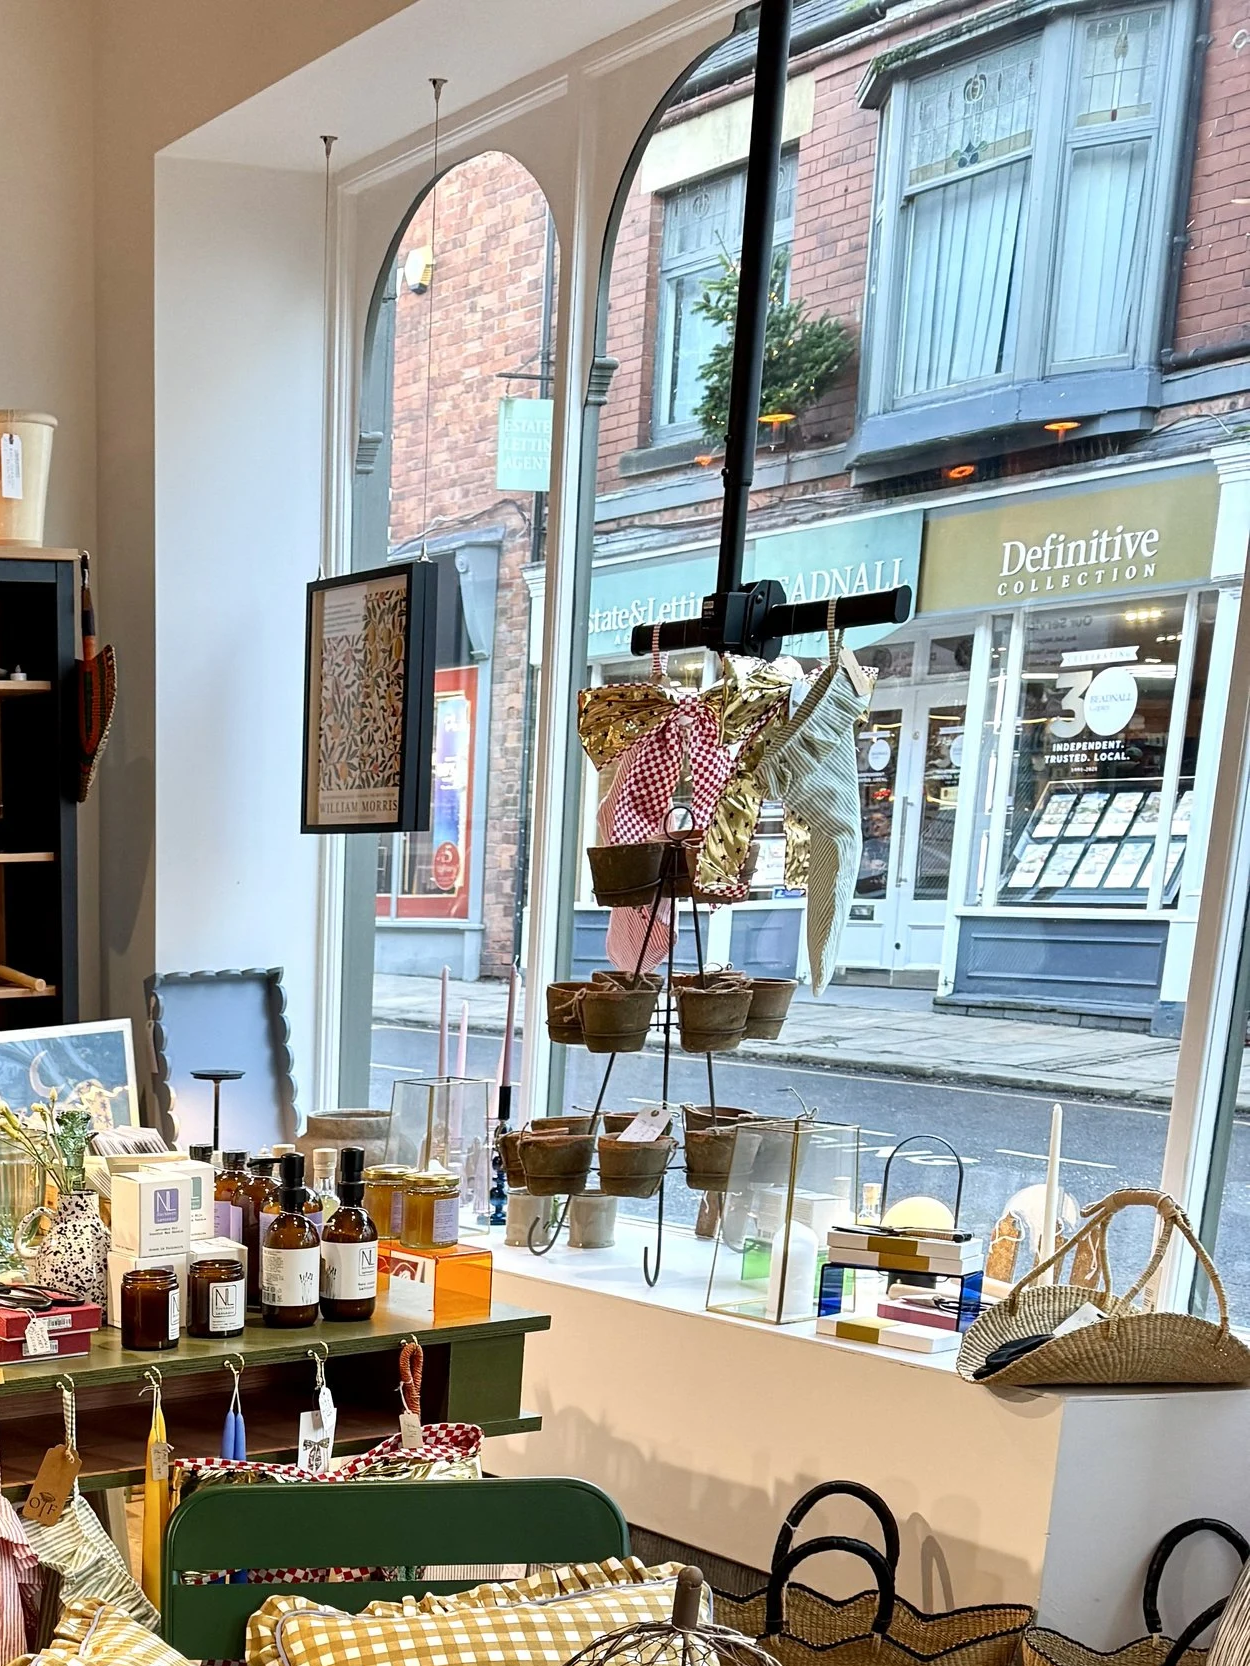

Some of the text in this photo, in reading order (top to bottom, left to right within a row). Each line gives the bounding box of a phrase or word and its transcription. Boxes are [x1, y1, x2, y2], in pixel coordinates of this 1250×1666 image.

[504, 419, 551, 434] ESTATE
[999, 525, 1159, 577] Definitive
[997, 563, 1157, 597] COLLECTION
[1052, 740, 1125, 752] INDEPENDENT.
[1044, 752, 1130, 764] TRUSTED. LOCAL.
[319, 799, 398, 814] WILLIAM MORRIS
